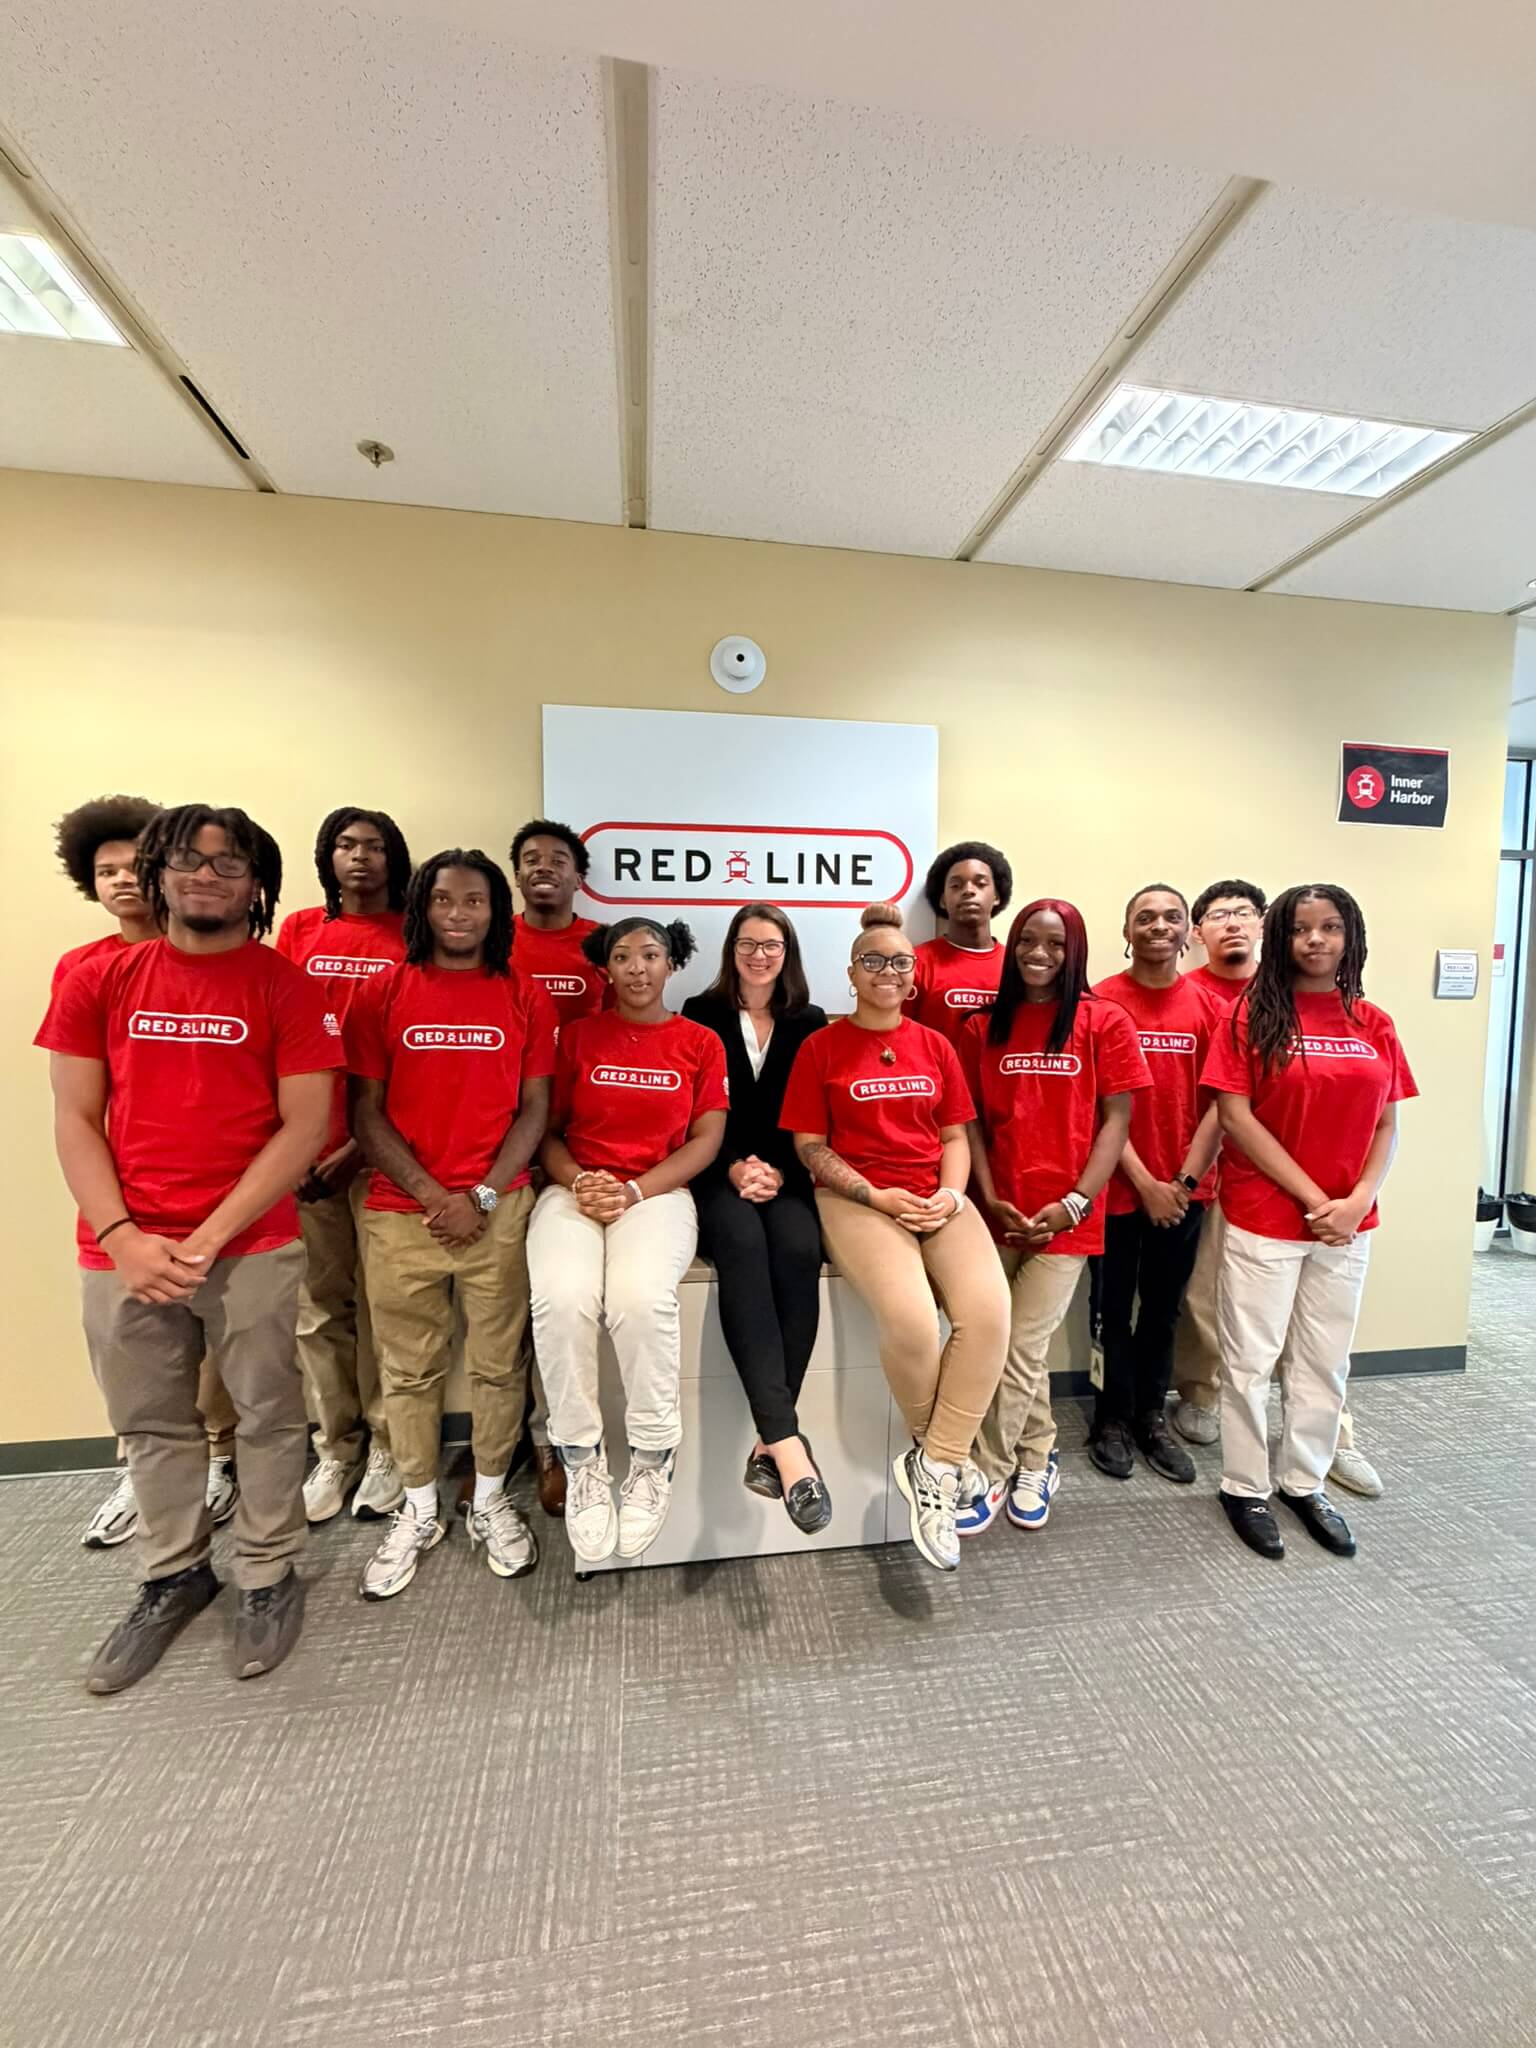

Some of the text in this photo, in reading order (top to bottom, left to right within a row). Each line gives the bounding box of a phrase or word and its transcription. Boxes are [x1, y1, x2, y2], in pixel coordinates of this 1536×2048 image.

[1391, 774, 1423, 788] Inner
[1390, 790, 1434, 805] Harbor
[614, 848, 873, 885] RED LINE
[315, 961, 343, 971] RED
[546, 980, 575, 990] LINE
[954, 994, 976, 1003] RED
[138, 1019, 232, 1036] RED LINE
[415, 1031, 493, 1044] RED LINE
[1162, 1038, 1190, 1048] LINE
[1335, 1043, 1369, 1054] LINE
[1006, 1059, 1071, 1070] RED LINE
[600, 1071, 671, 1085] RED LINE
[860, 1081, 928, 1095] RED LINE
